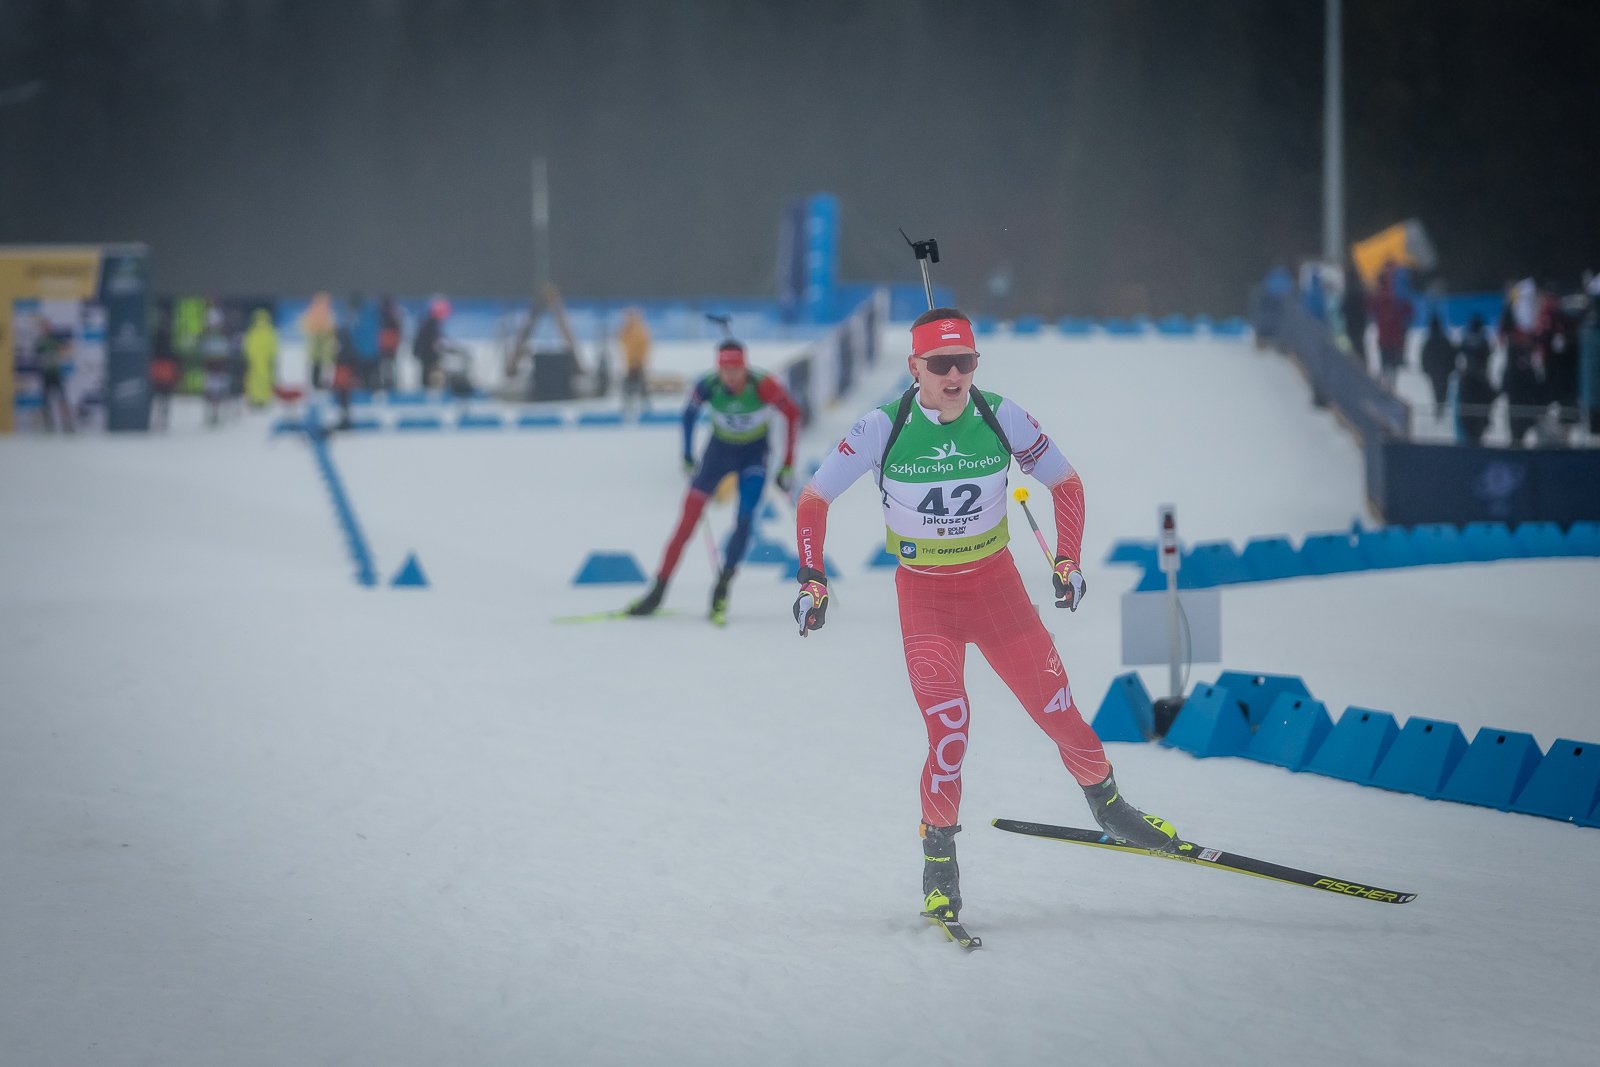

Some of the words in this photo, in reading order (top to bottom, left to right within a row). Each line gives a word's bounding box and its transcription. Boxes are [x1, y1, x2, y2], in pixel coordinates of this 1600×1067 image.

[890, 461, 953, 477] Szklarska
[958, 455, 1001, 469] Poręba
[917, 483, 983, 517] 42
[922, 514, 980, 526] Jakuszyce
[922, 547, 936, 555] THE
[937, 546, 972, 555] OFFICIAL
[973, 542, 986, 551] IBU
[985, 535, 997, 546] APP
[925, 697, 967, 794] POL
[1313, 878, 1398, 903] FISCHER
